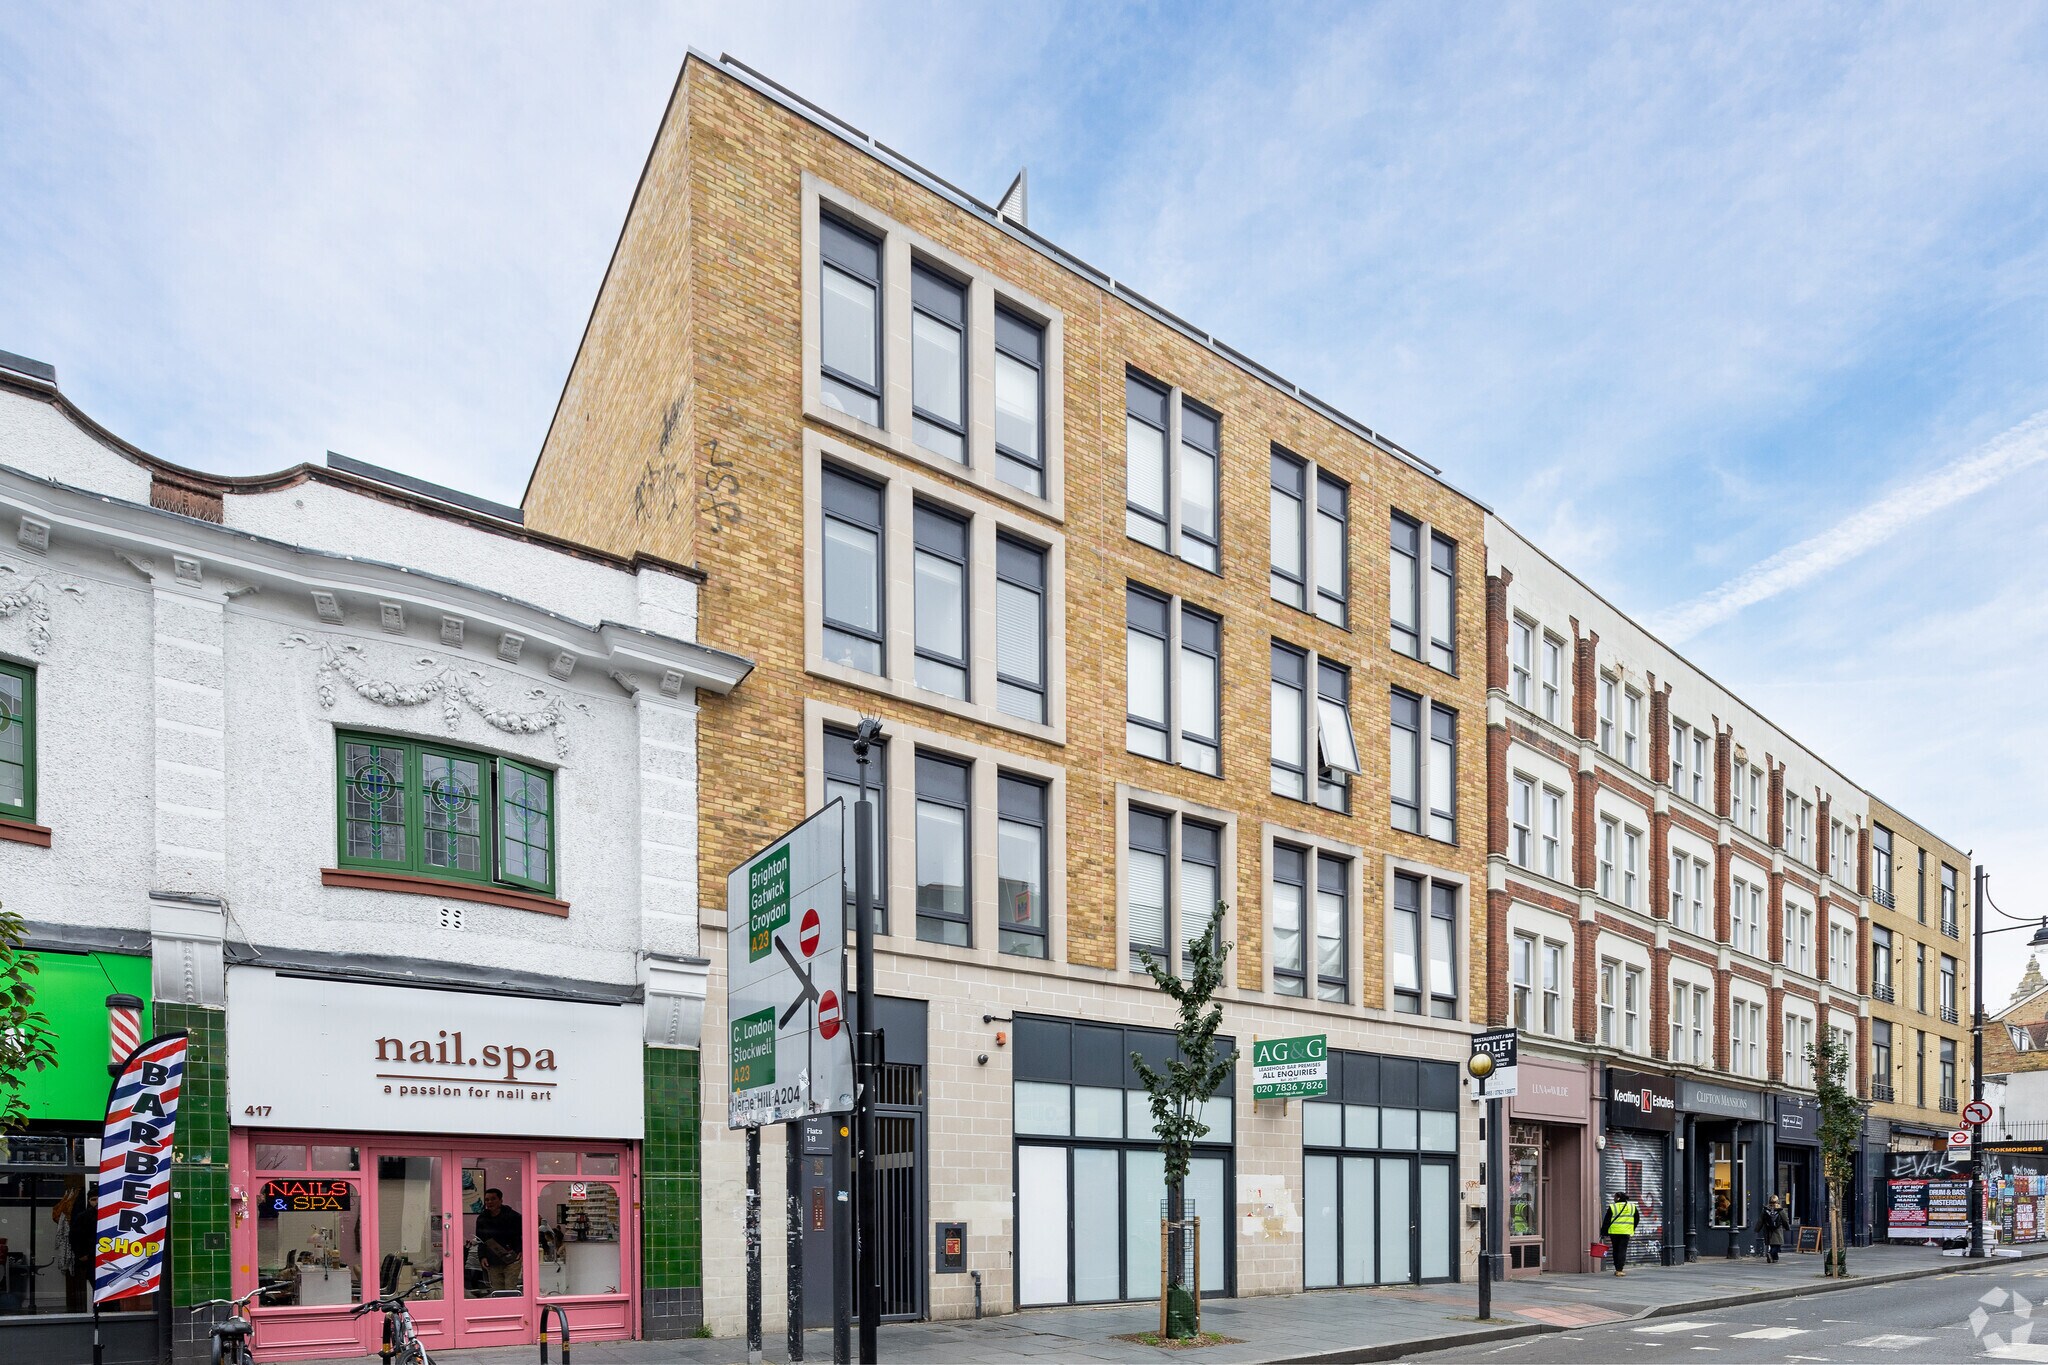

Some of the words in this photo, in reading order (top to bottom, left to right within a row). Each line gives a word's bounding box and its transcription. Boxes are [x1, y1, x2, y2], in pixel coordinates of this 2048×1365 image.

[751, 857, 787, 889] Brighton
[751, 879, 785, 910] Gatwick
[751, 903, 786, 932] Croydon
[734, 1026, 742, 1042] C.
[744, 1018, 773, 1039] London
[1473, 1035, 1502, 1043] RESTAURANT
[734, 1037, 772, 1063] Stockwell
[1257, 1039, 1323, 1063] AG&G
[1474, 1042, 1490, 1051] TO
[1493, 1039, 1513, 1052] LET
[375, 1030, 557, 1080] nail.spa
[1258, 1064, 1285, 1072] LEASEHOLD
[1277, 1068, 1317, 1078] ENQUIRIES
[384, 1085, 392, 1094] a
[400, 1085, 461, 1096] passion
[468, 1086, 490, 1098] for
[497, 1088, 524, 1100] nail
[531, 1089, 551, 1101] art
[1256, 1085, 1273, 1093] 020
[1276, 1083, 1297, 1092] 7836
[1301, 1081, 1323, 1090] 7826
[757, 1091, 771, 1108] Hill
[1614, 1089, 1640, 1107] Keating
[1653, 1095, 1675, 1109] Estates
[1696, 1090, 1720, 1105] CLIFTON
[1721, 1094, 1748, 1109] MANSIONS
[244, 1105, 272, 1116] 417
[806, 1127, 823, 1135] Flats
[116, 1060, 170, 1236] BARBER
[268, 1182, 347, 1196] NAILS
[273, 1198, 288, 1210] &
[293, 1196, 343, 1210] SPA
[98, 1236, 160, 1257] SHOP
